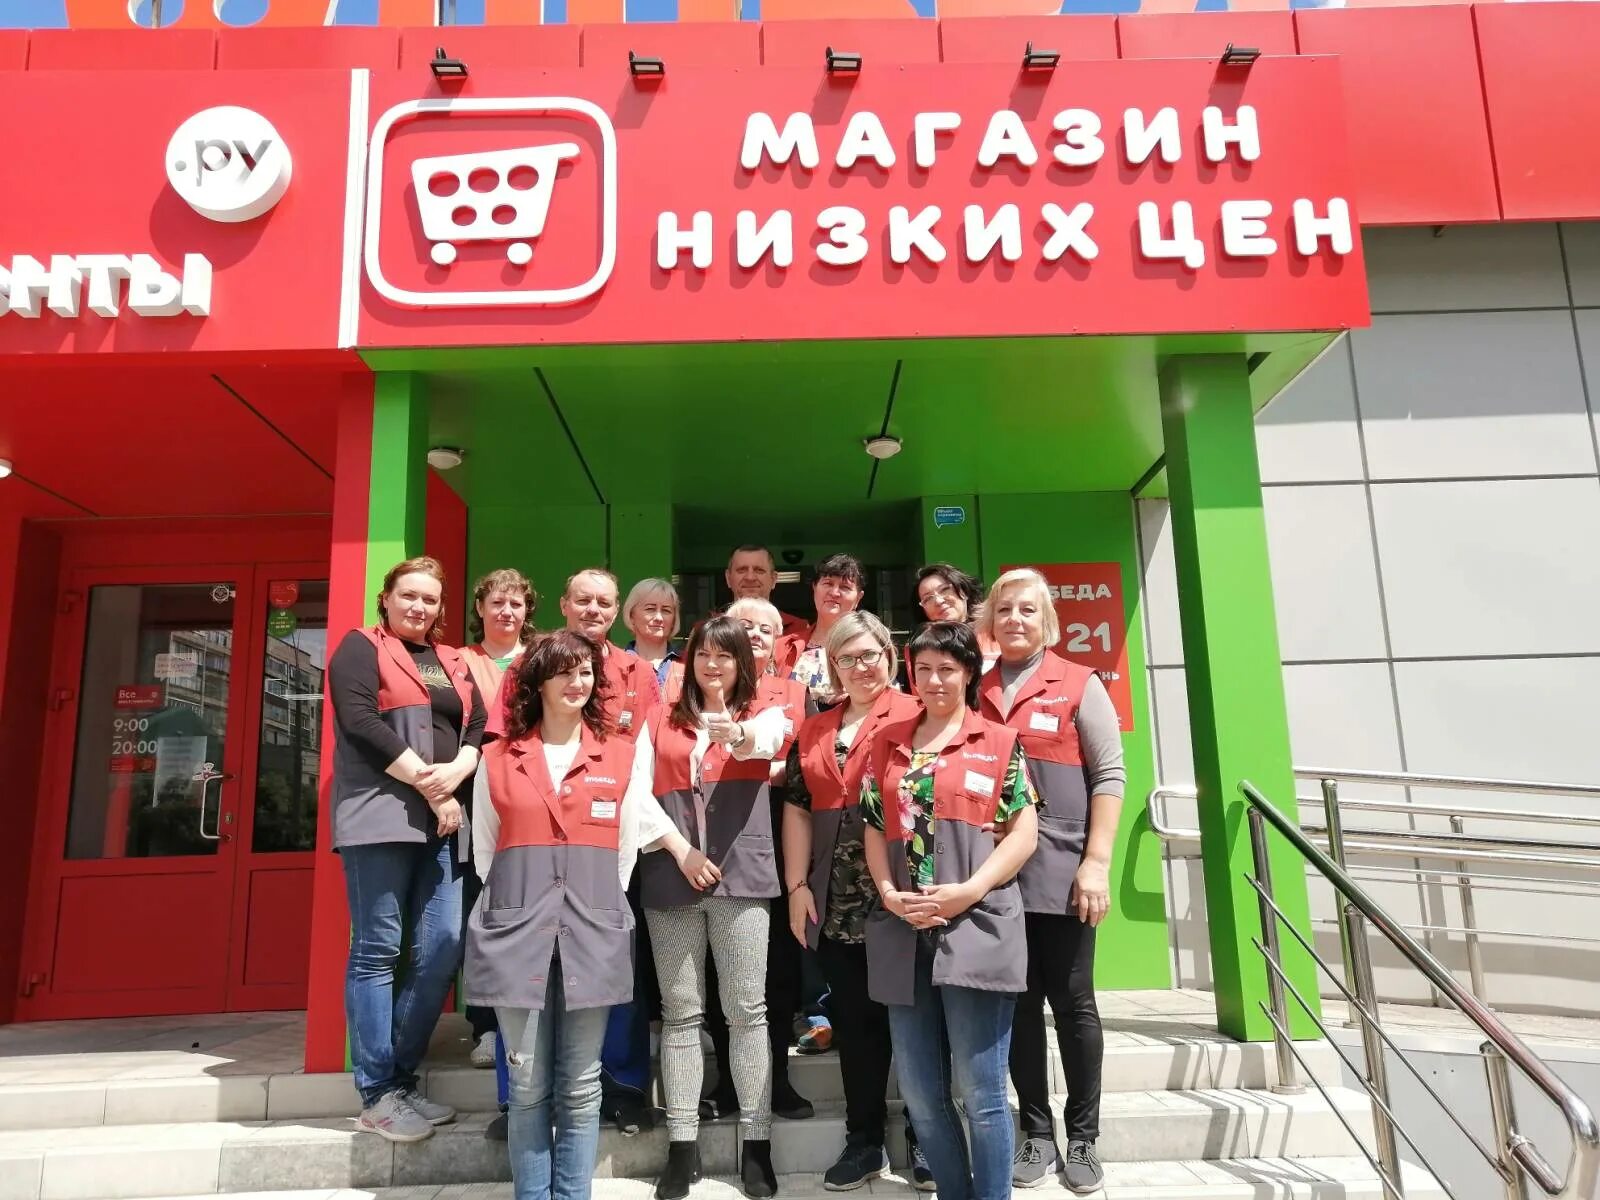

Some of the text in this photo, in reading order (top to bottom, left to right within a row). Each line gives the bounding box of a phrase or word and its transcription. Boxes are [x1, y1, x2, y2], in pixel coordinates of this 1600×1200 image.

[741, 106, 1261, 169] МАГАЗИН
[175, 139, 273, 187] .ру
[657, 198, 1353, 269] НИЗКИХ ЦЕН
[0, 253, 213, 318] нты
[1050, 583, 1112, 601] БЕДА
[1066, 621, 1112, 652] 21
[113, 719, 149, 732] 9:00
[112, 740, 157, 755] 20:00
